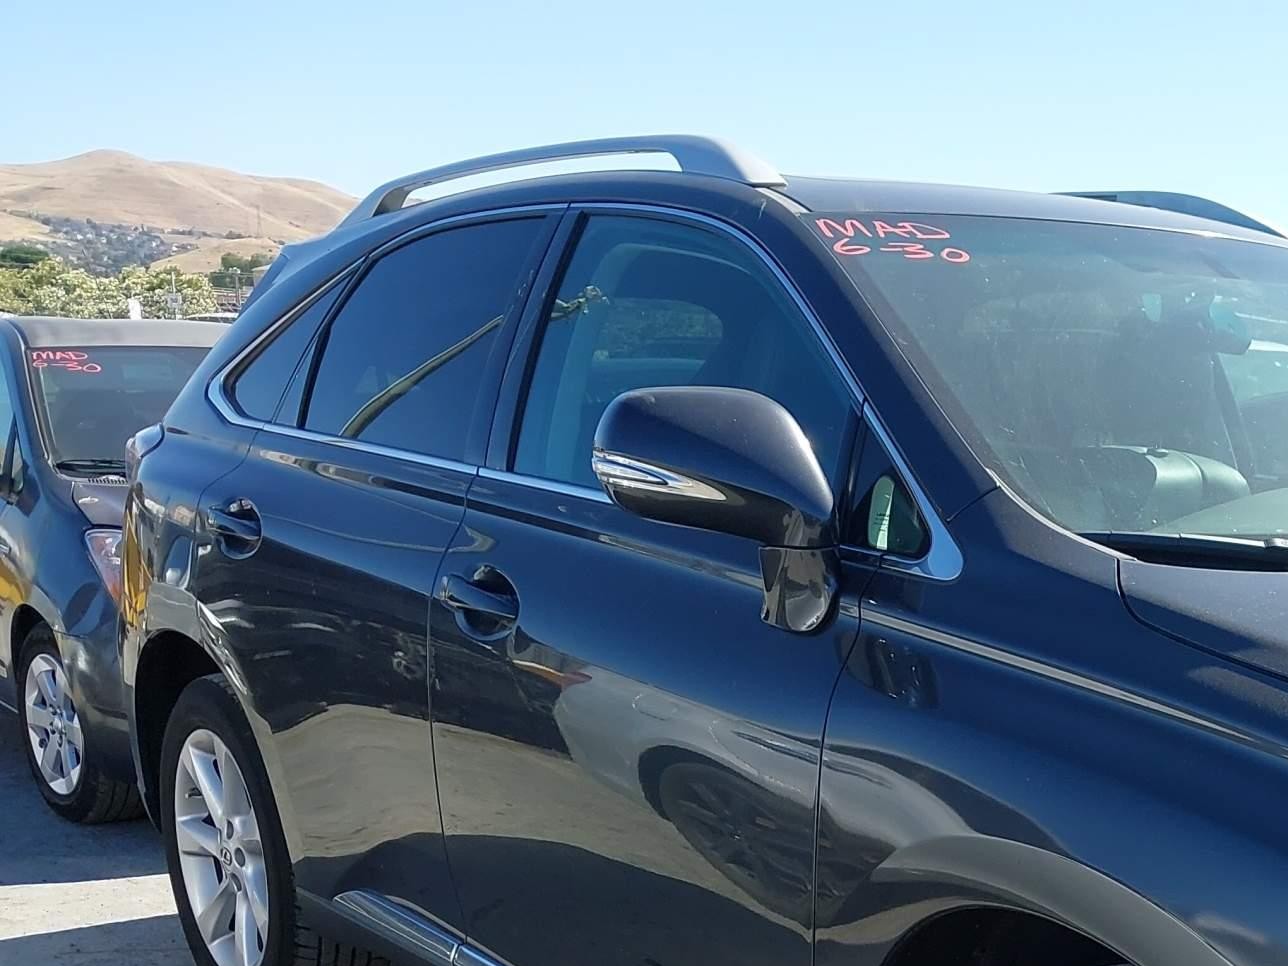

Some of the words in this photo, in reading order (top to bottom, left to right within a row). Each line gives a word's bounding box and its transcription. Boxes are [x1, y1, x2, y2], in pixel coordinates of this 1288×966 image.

[815, 218, 951, 239] MAD
[832, 238, 971, 264] 6-30
[31, 350, 89, 360] MAD
[32, 360, 102, 373] 6-30
